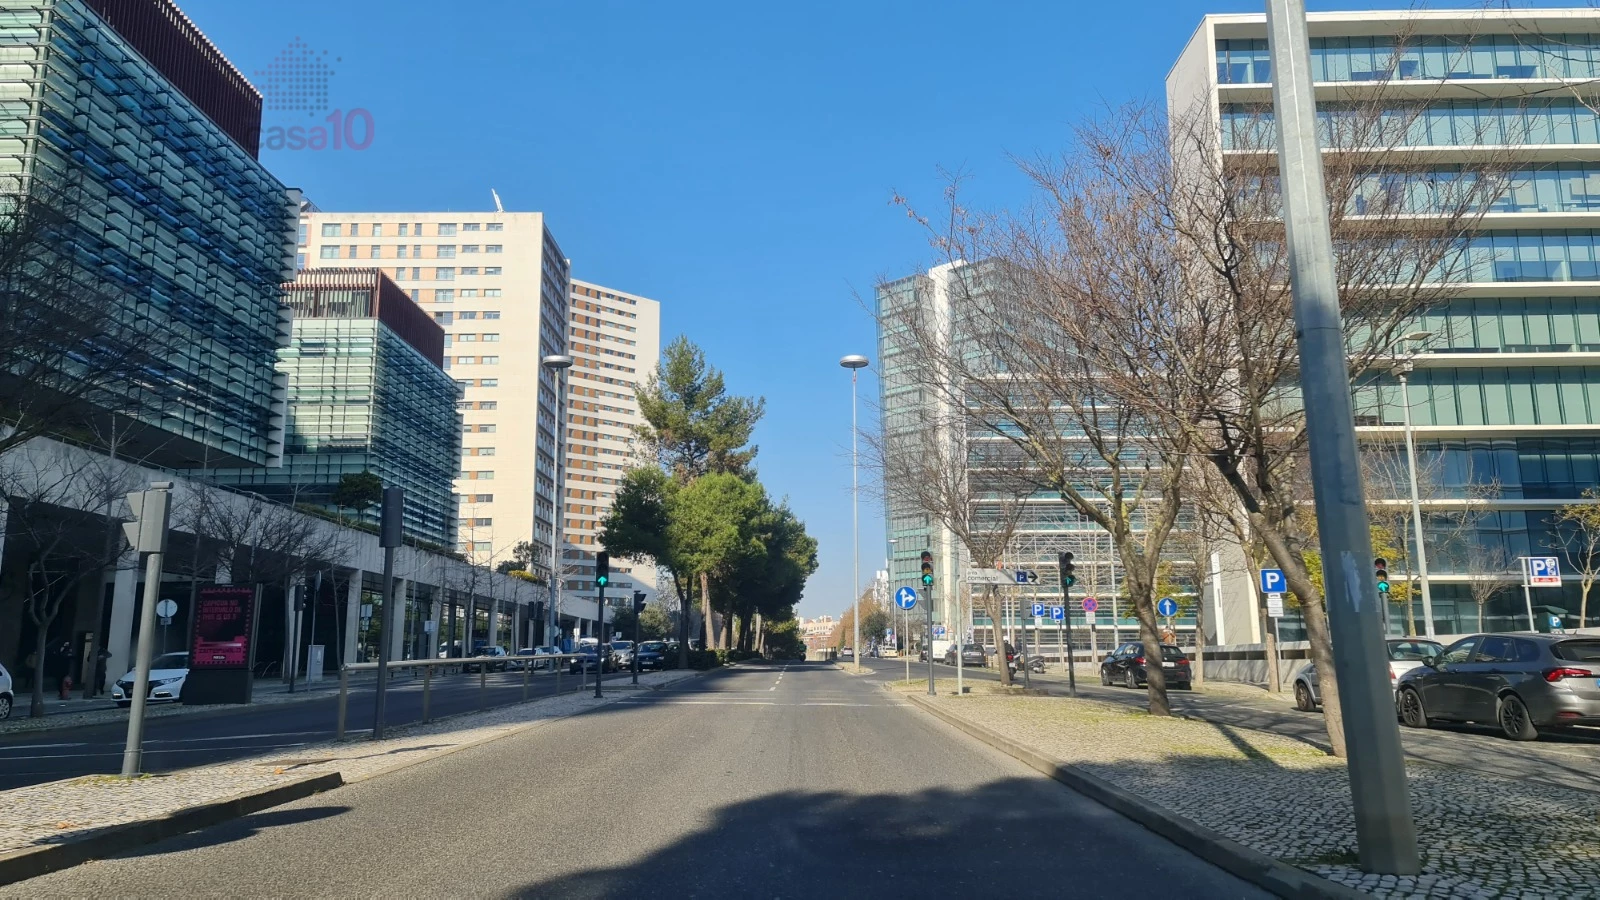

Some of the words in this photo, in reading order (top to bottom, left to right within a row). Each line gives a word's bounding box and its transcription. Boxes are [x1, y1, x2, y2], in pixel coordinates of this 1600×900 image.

[1532, 560, 1545, 575] P
[1266, 572, 1280, 589] P
[1034, 605, 1042, 615] P
[1052, 607, 1061, 618] P
[1552, 616, 1560, 627] P
